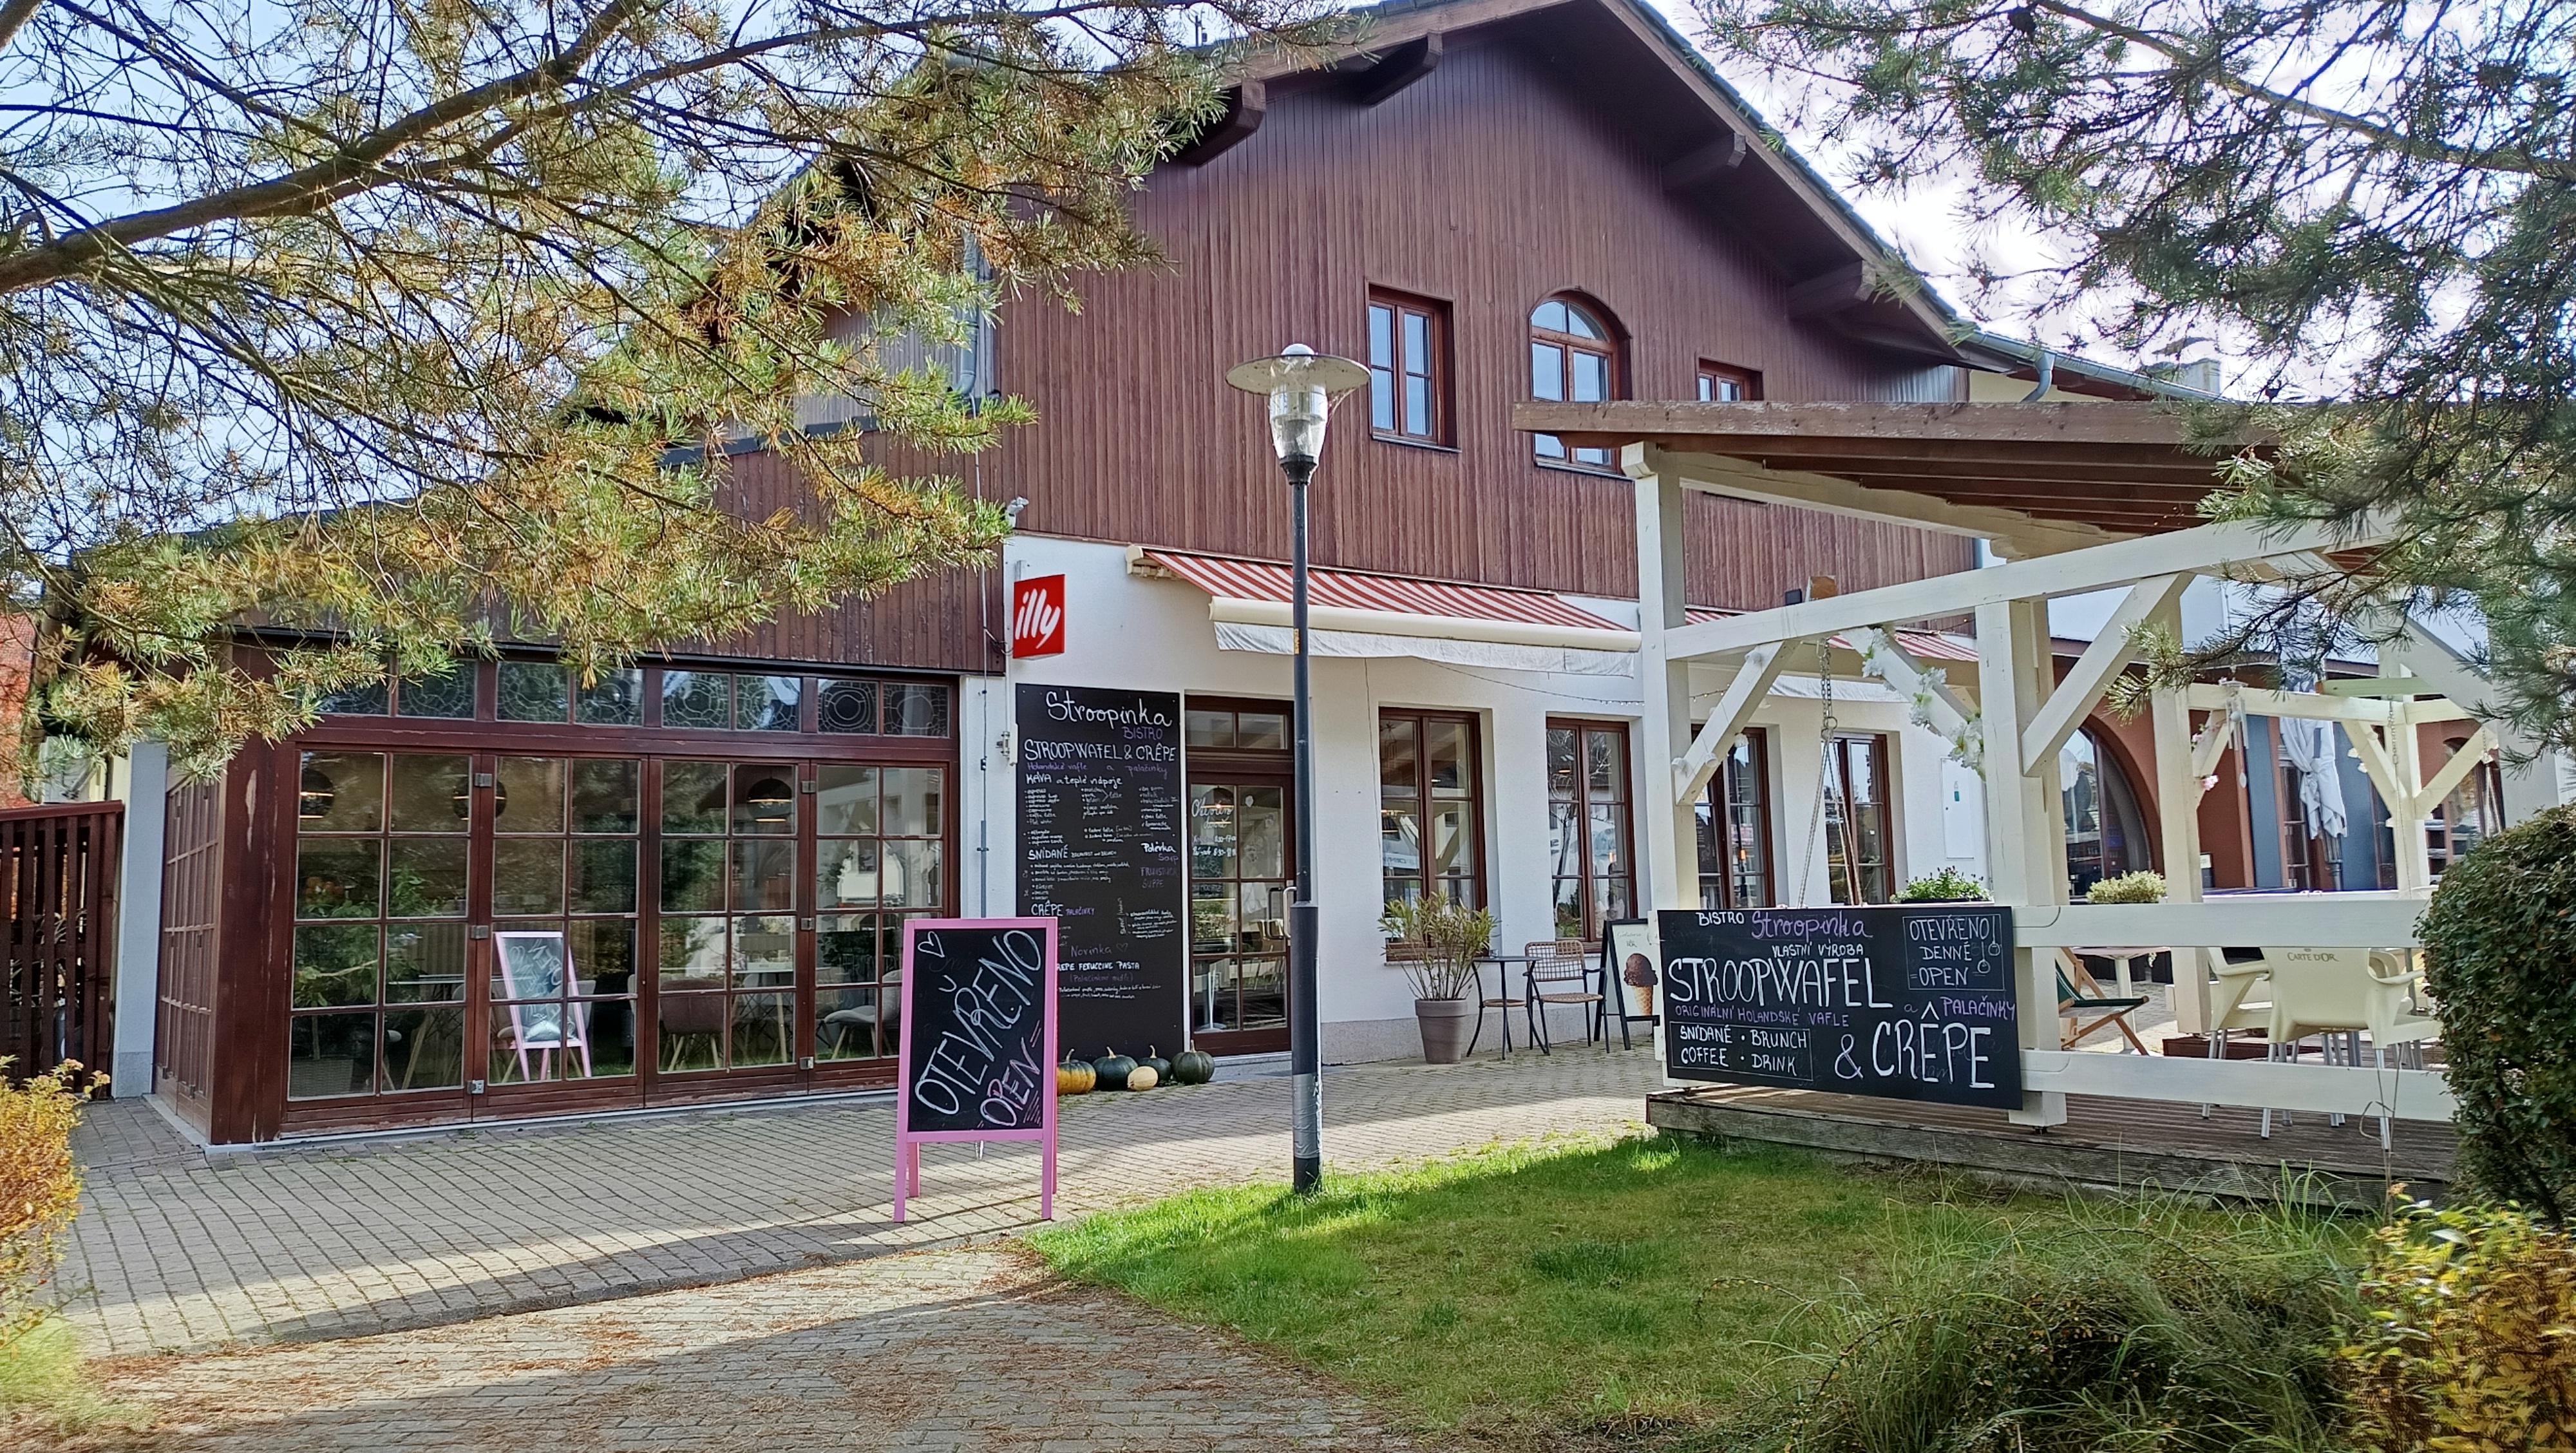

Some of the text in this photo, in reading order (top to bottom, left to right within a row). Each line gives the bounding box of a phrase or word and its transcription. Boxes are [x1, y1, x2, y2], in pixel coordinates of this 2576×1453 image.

[1015, 588, 1061, 649] illy
[1046, 690, 1173, 729] Stroopinka
[1122, 726, 1163, 741] BISTRO
[1024, 739, 1177, 761] STROOPWAFEL & CRÊPE
[1026, 771, 1052, 784] KÁVA
[1031, 900, 1064, 916] CRÊPE
[1696, 910, 1873, 942] BISTRO Stroopinka
[1772, 938, 1864, 958] VLASTNÍ VÝROBA
[2287, 953, 2312, 961] CARTE
[1668, 957, 1894, 1009] STROOPWAFEL
[1919, 967, 1969, 986] OPEN
[1675, 1004, 1850, 1027] ORIGINÁLNÍ HOLANDSKÉ VAFLE
[1904, 995, 2016, 1021] a PALAČINKY
[1750, 1029, 1807, 1049] BRUNCH
[1834, 1001, 1995, 1088] & CRÊPE
[1681, 1047, 1797, 1076] COFFEE DRINK
[980, 1037, 1040, 1126] OPEN
